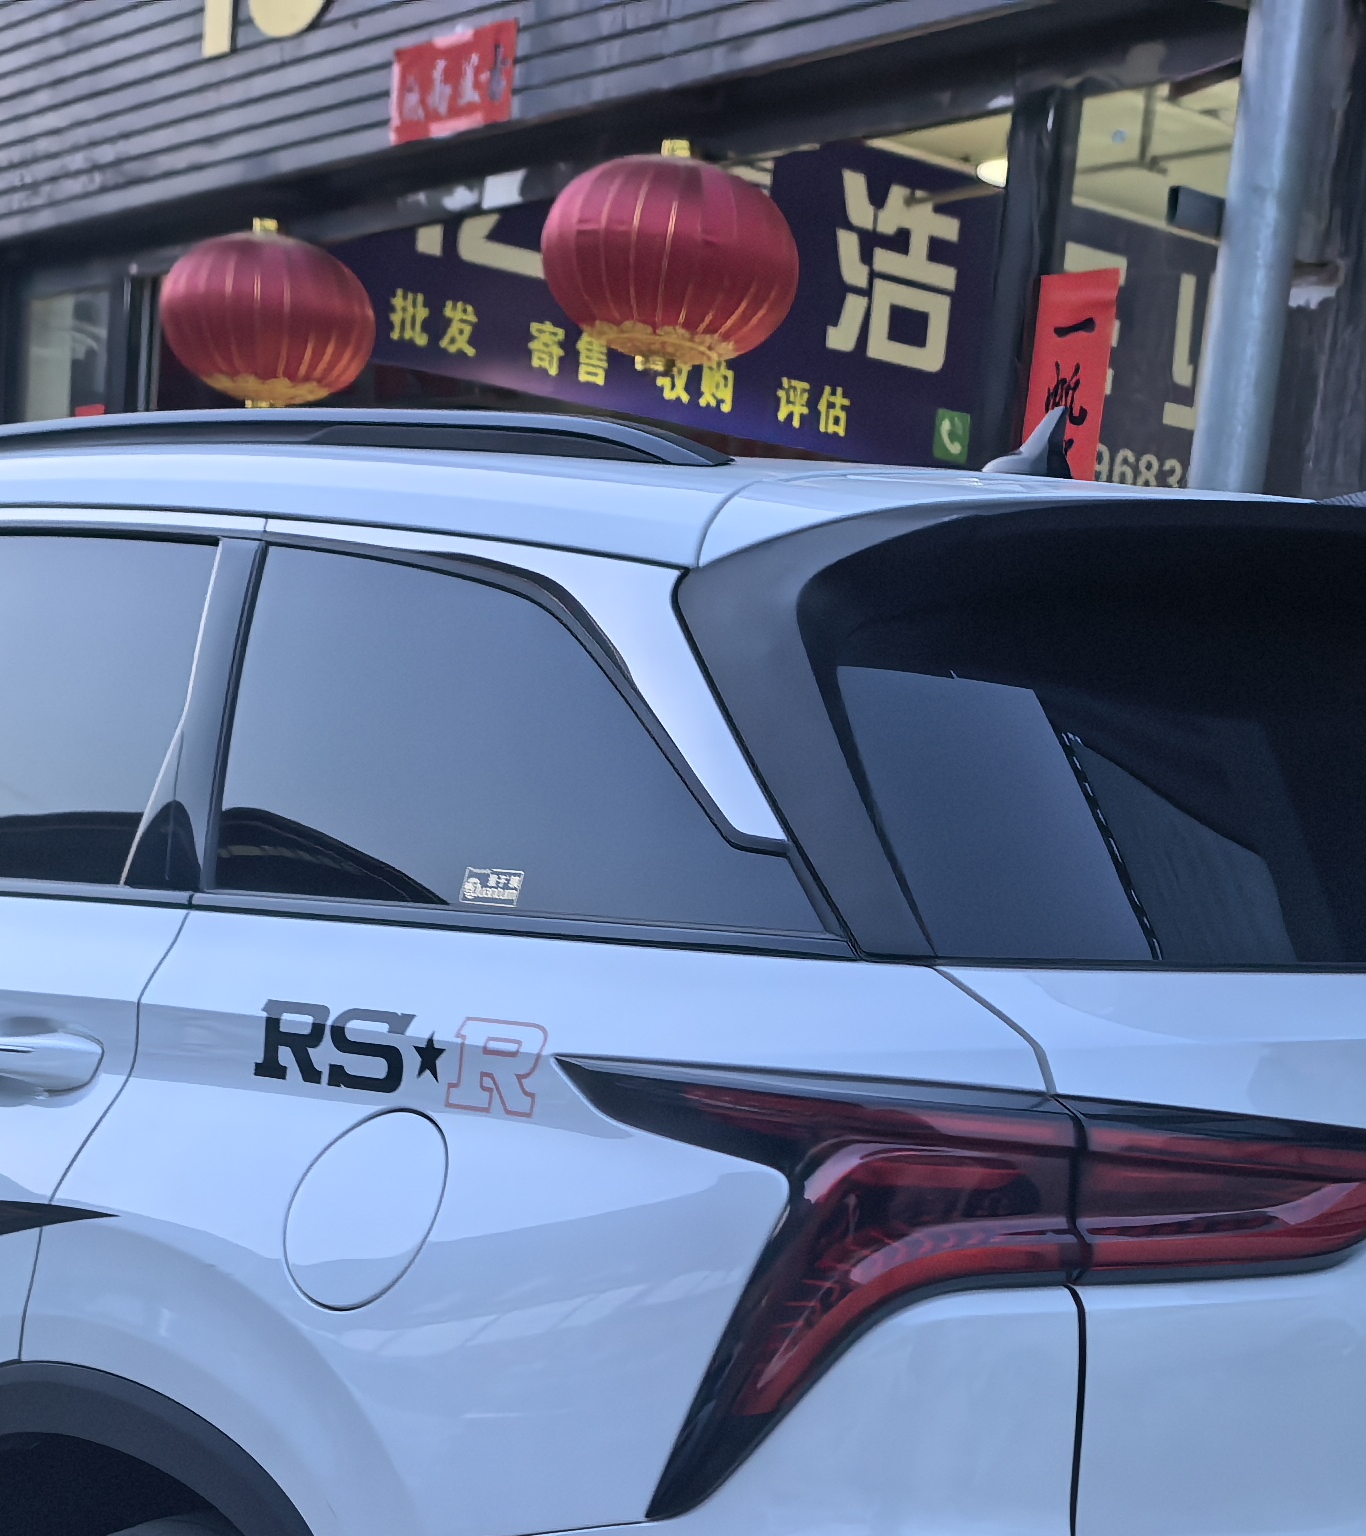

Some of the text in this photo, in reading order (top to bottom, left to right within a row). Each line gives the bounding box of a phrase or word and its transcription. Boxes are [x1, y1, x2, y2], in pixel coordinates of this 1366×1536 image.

[389, 287, 479, 358] 批发
[527, 320, 610, 387] 寄售
[776, 375, 851, 438] 评估
[253, 998, 549, 1119] RS R
